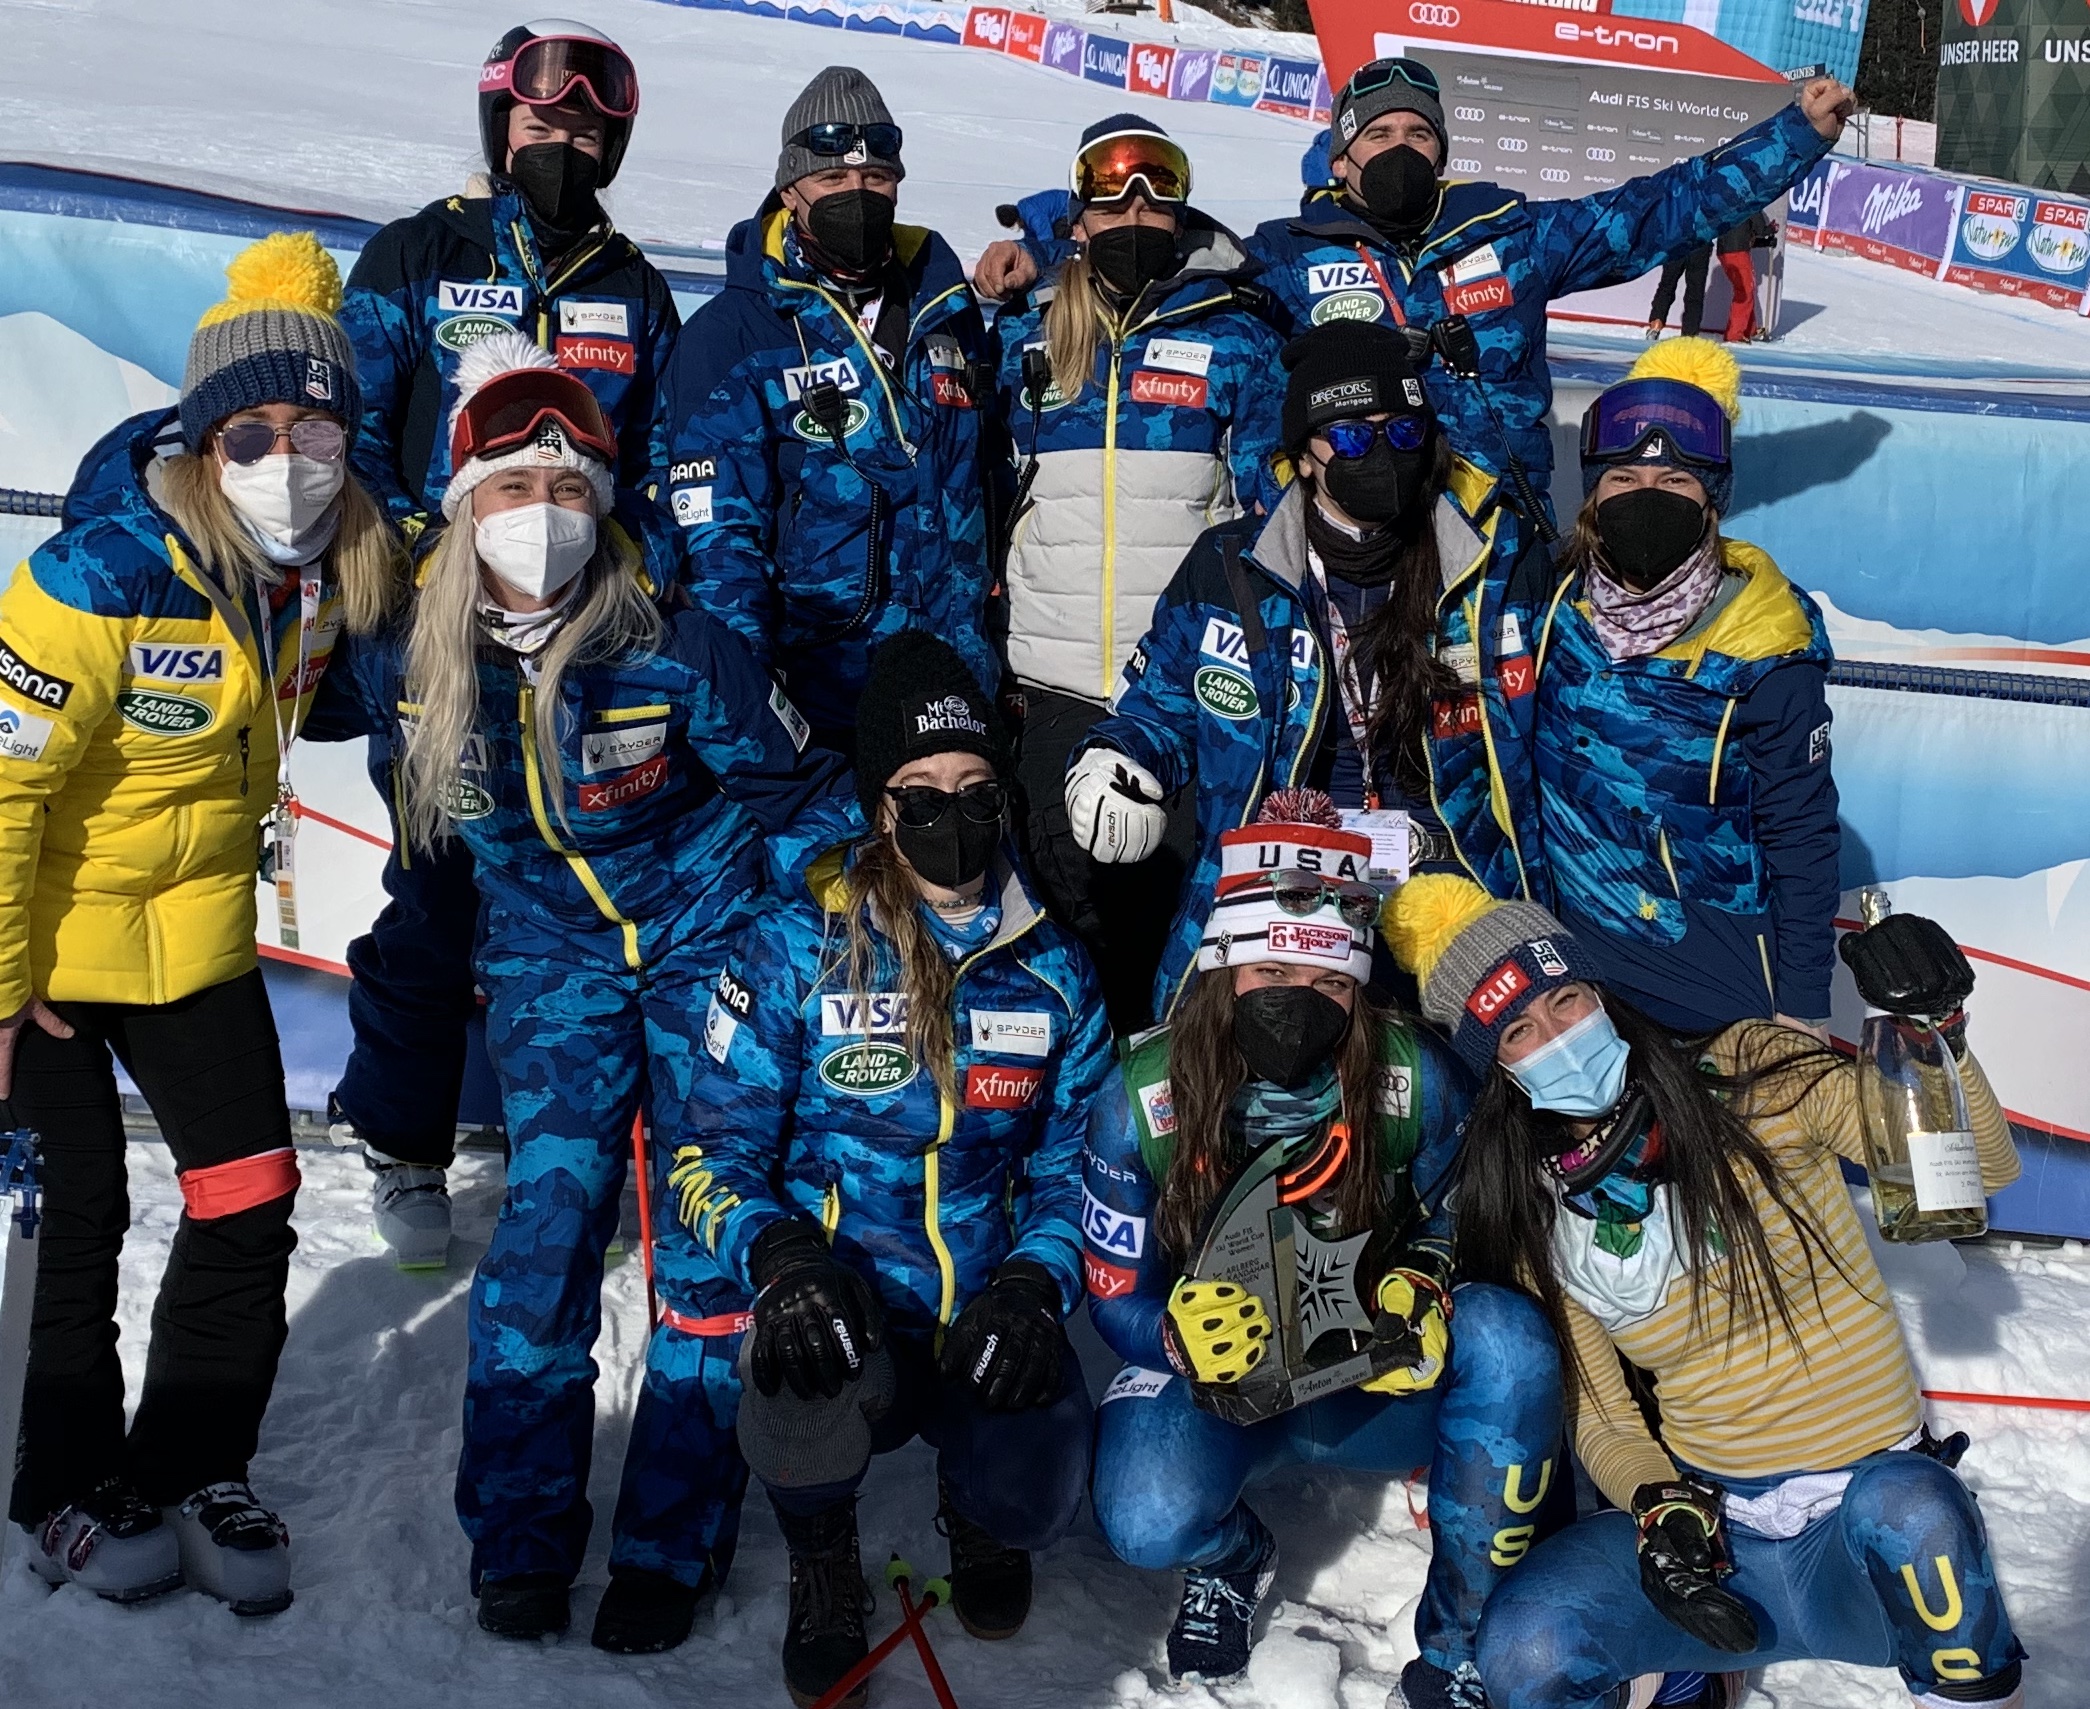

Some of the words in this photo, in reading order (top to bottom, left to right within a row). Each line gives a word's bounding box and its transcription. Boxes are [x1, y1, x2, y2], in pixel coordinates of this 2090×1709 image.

[1554, 21, 1679, 55] e-tron
[1940, 41, 1979, 66] UNSER
[1982, 39, 2019, 63] HEER
[1779, 65, 1816, 82] ONGINES
[1588, 90, 1623, 107] Audi
[1626, 94, 1650, 109] FIS
[1653, 98, 1673, 112] Ski
[1676, 101, 1719, 117] World
[1723, 107, 1749, 123] Cup
[1861, 178, 1923, 235] Milka
[1977, 197, 2014, 215] SPAR
[2043, 206, 2087, 227] SPAR
[1312, 266, 1379, 288] VISA
[444, 285, 519, 311] VISA
[1326, 299, 1359, 313] LAND
[453, 322, 494, 334] LAND
[581, 312, 623, 322] SPYDER
[563, 342, 628, 368] xfinity
[1165, 349, 1207, 361] SPYDER
[788, 361, 855, 392] VISA
[1136, 376, 1202, 401] xfinity
[670, 460, 715, 484] SANA
[135, 648, 223, 678] VISA
[1206, 672, 1242, 696] LAND
[131, 696, 184, 716] LAND
[925, 700, 949, 719] Mt
[1205, 686, 1248, 713] ROVER
[131, 706, 196, 729] ROVER
[915, 712, 987, 736] Bachelor
[609, 735, 662, 754] SPYDER
[1812, 725, 1829, 744] US
[587, 763, 662, 807] xfinity
[1288, 926, 1349, 948] JACKSON
[1298, 938, 1334, 951] HOLE
[1478, 969, 1519, 1013] CLIF
[996, 1023, 1046, 1036] SPYDER
[840, 1053, 888, 1068] LAND
[844, 1067, 901, 1084] ROVER
[975, 1073, 1039, 1102] xfinity
[1083, 1192, 1137, 1254] ISA
[832, 1317, 860, 1370] reusch
[971, 1333, 999, 1384] reusch
